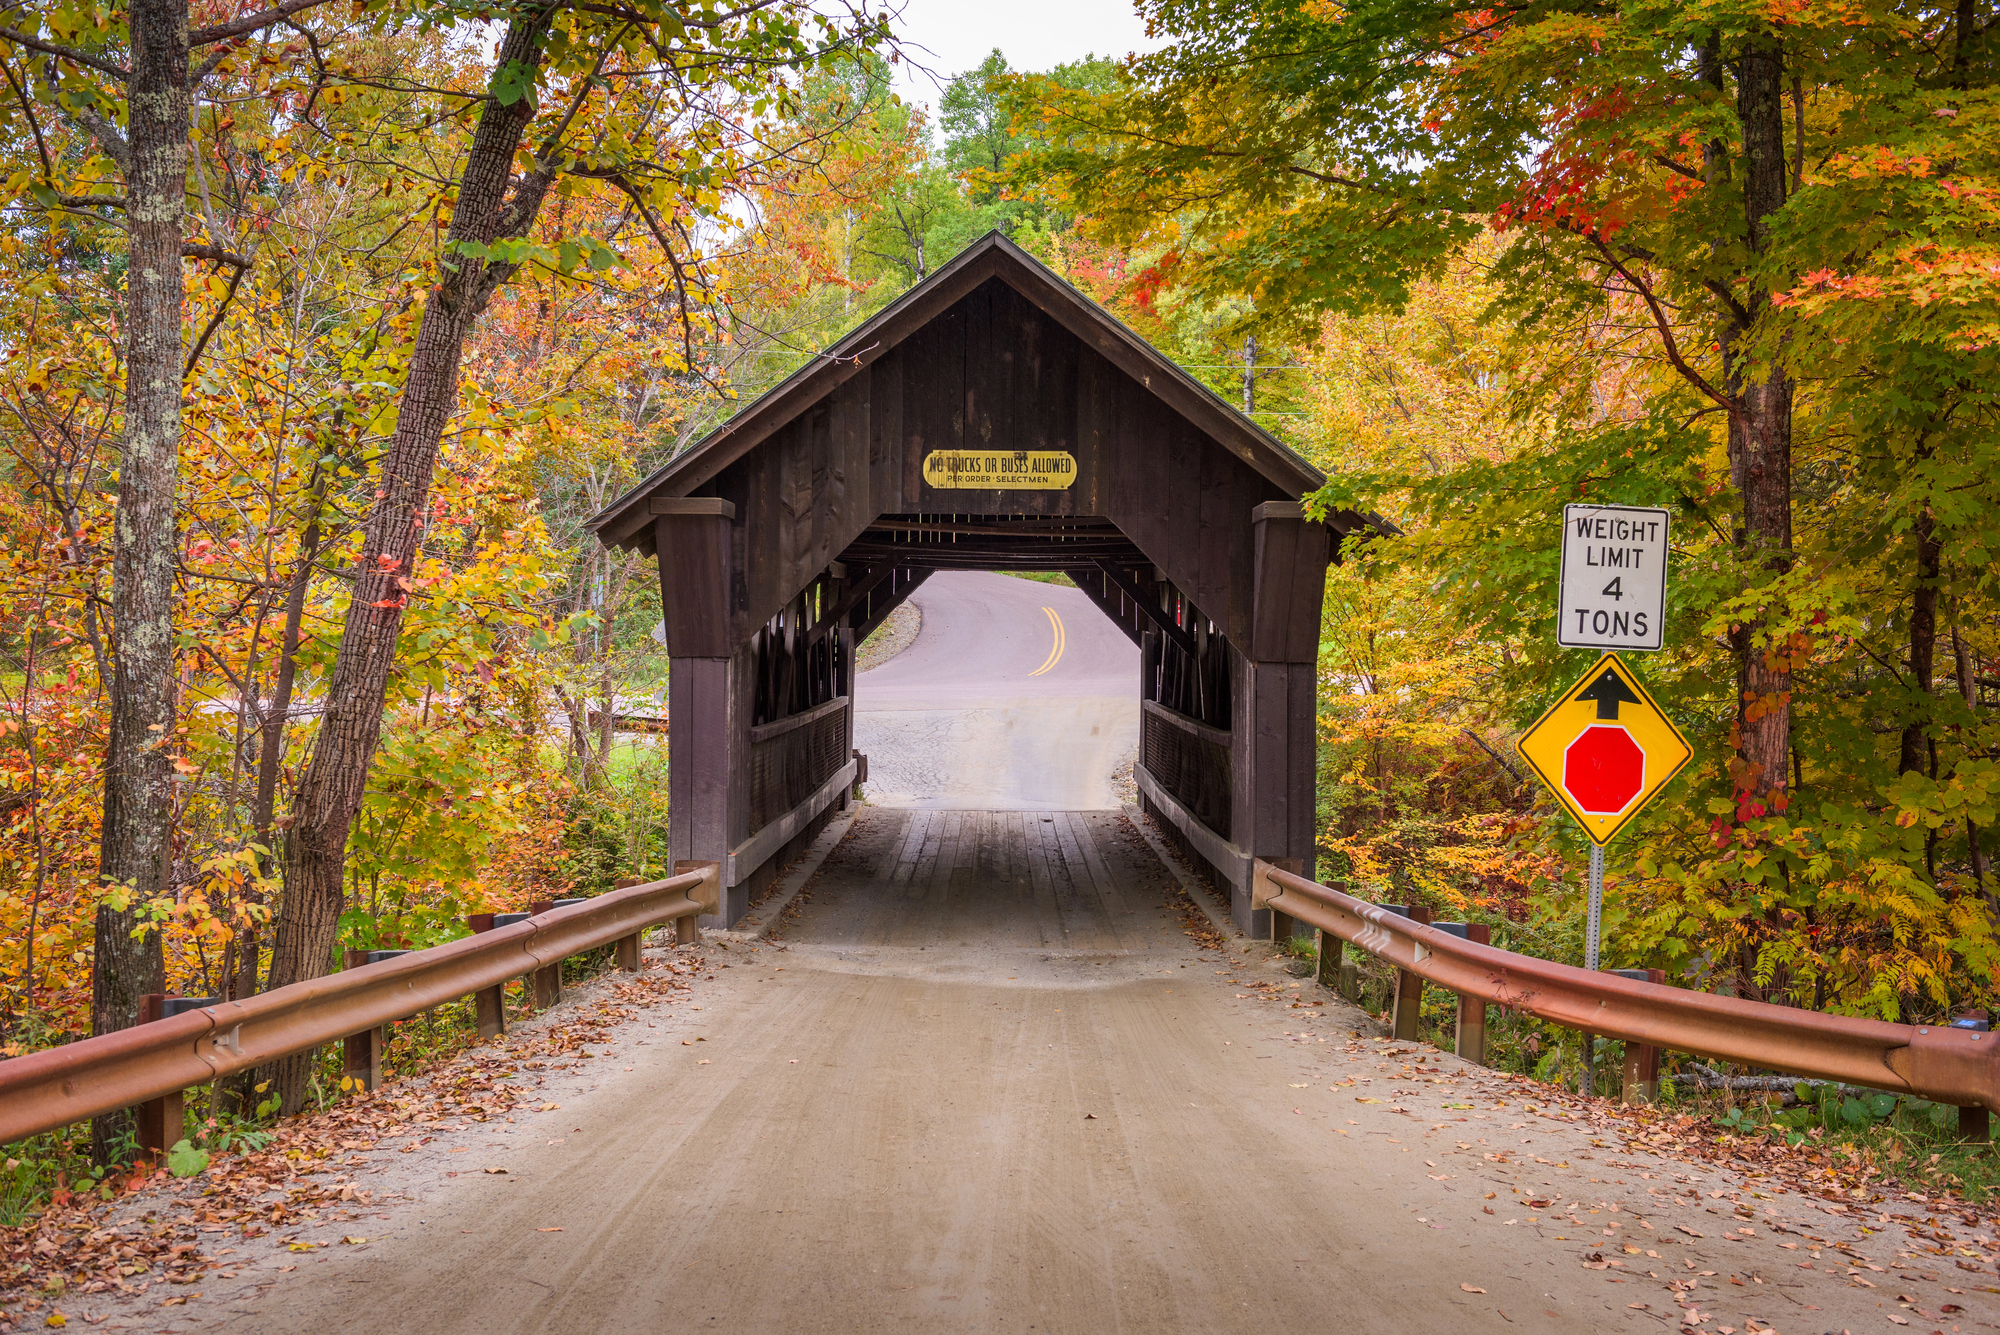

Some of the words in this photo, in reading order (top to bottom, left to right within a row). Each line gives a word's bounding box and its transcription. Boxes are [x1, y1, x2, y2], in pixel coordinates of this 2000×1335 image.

[929, 457, 943, 473] NO
[946, 457, 981, 473] TRUCKS
[985, 458, 997, 473] OR
[1001, 458, 1028, 473] BUSES
[1032, 458, 1071, 473] ALLOWED
[996, 475, 1048, 483] SELECTMEN
[1577, 518, 1659, 542] WEIGHT
[1587, 546, 1643, 569] LIMIT
[1602, 576, 1623, 601] 4
[1575, 609, 1648, 637] TONS
